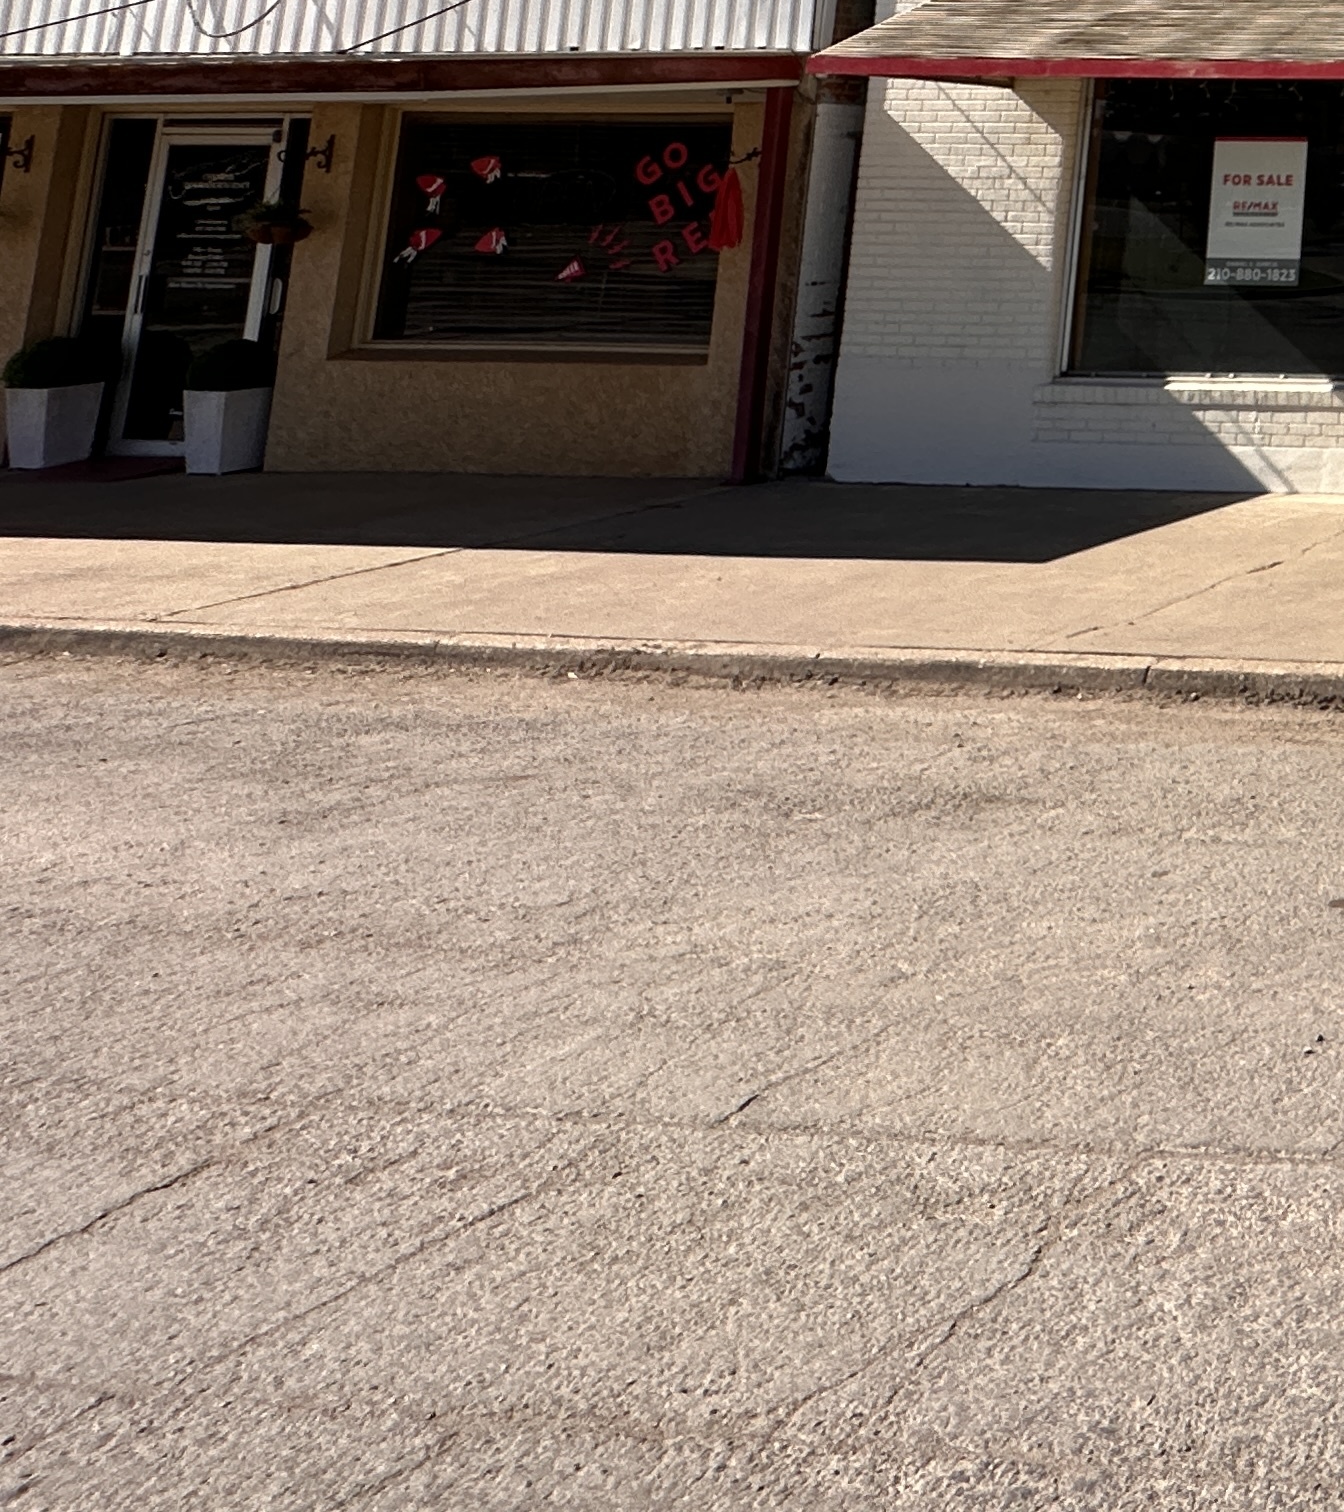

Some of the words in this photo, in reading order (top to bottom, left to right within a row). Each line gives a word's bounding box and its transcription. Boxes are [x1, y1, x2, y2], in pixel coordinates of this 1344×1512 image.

[634, 141, 689, 185] GO
[1223, 174, 1252, 186] FOR
[1256, 174, 1294, 186] SALE
[1232, 200, 1279, 211] RE/MAX
